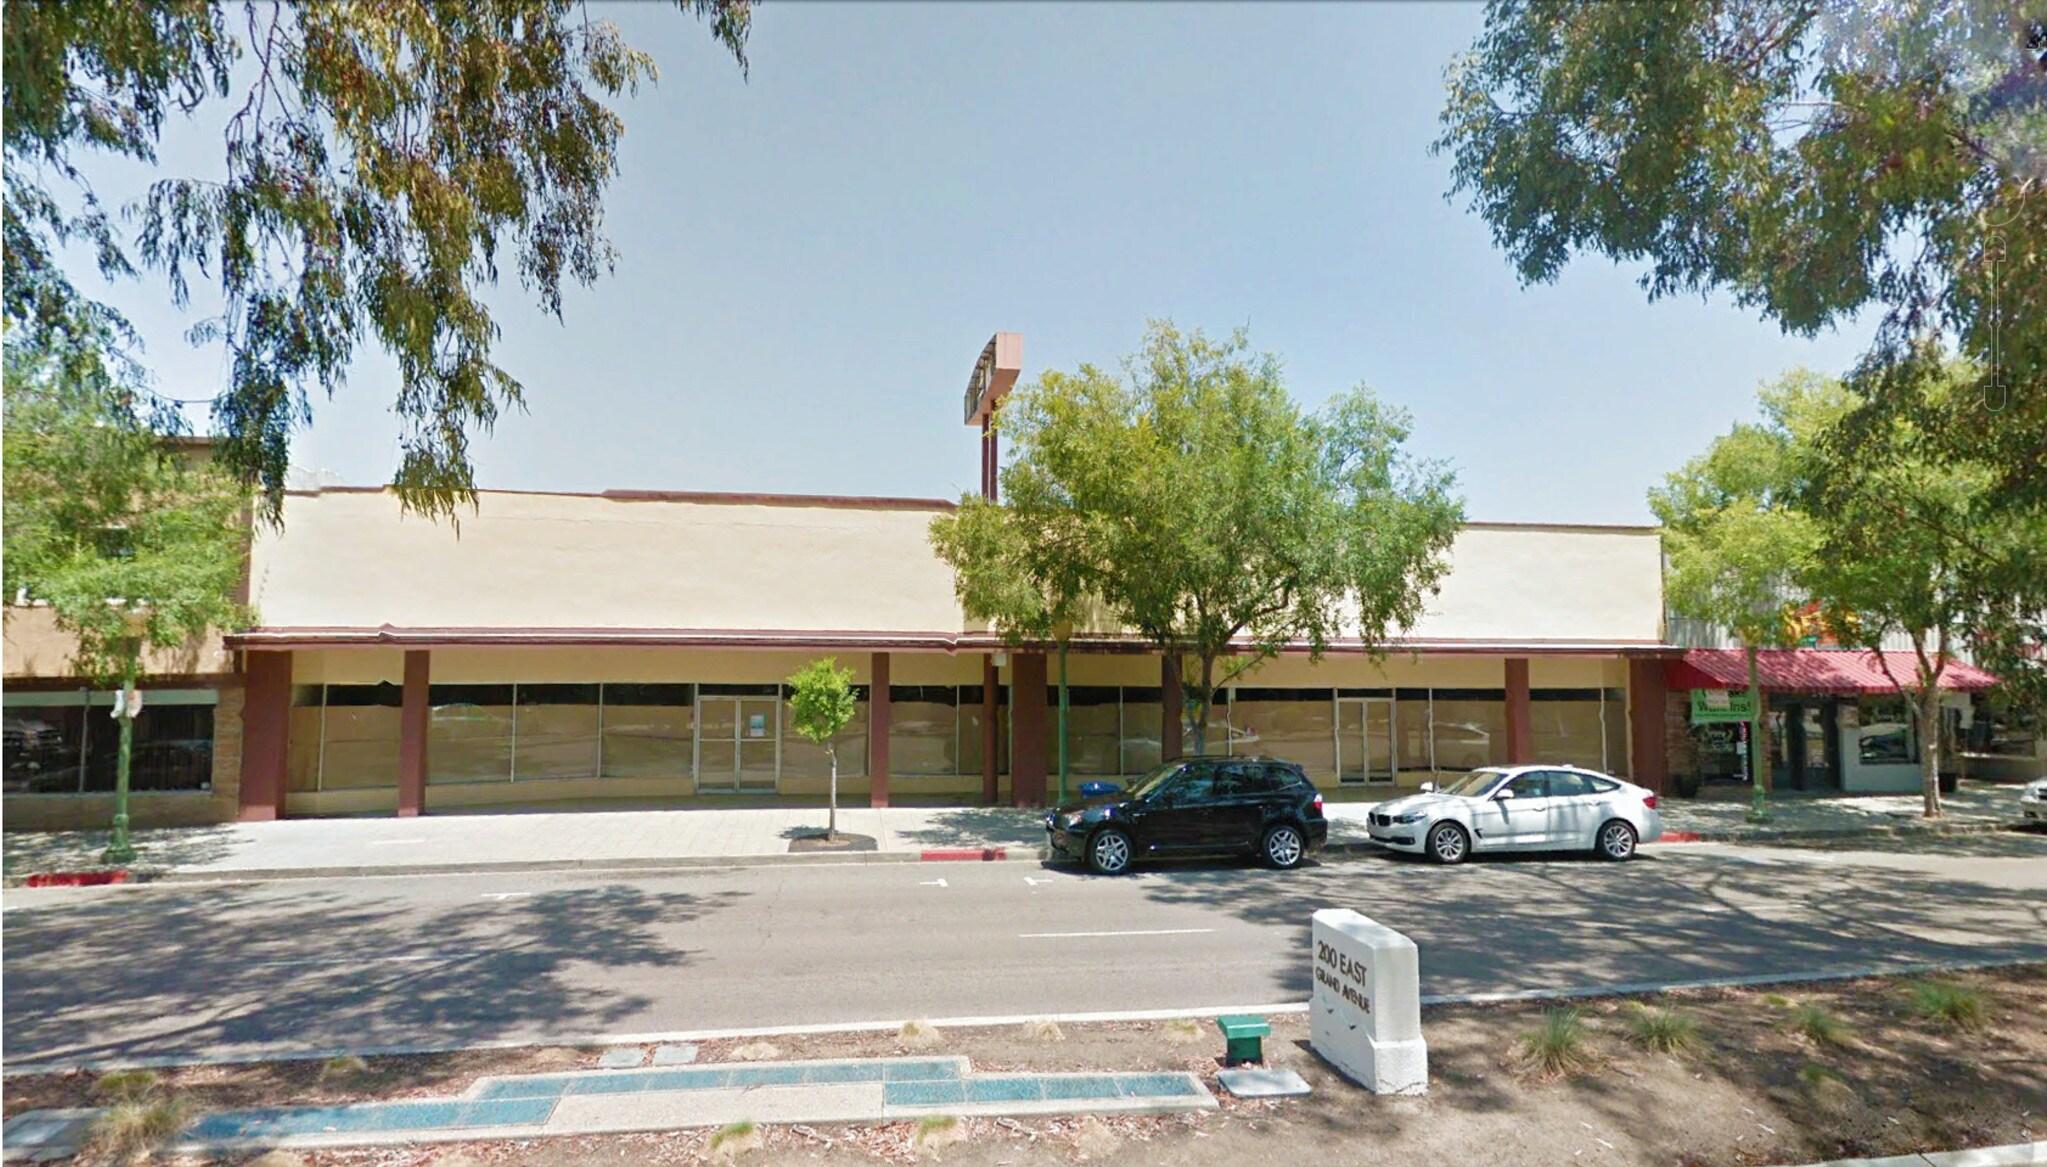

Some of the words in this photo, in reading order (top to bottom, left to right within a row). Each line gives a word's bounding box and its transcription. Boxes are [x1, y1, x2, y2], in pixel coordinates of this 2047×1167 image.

[1317, 940, 1338, 969] 200
[1340, 953, 1367, 987] EAST
[1315, 966, 1341, 993] GRAND
[1341, 984, 1370, 1015] AVENUE
